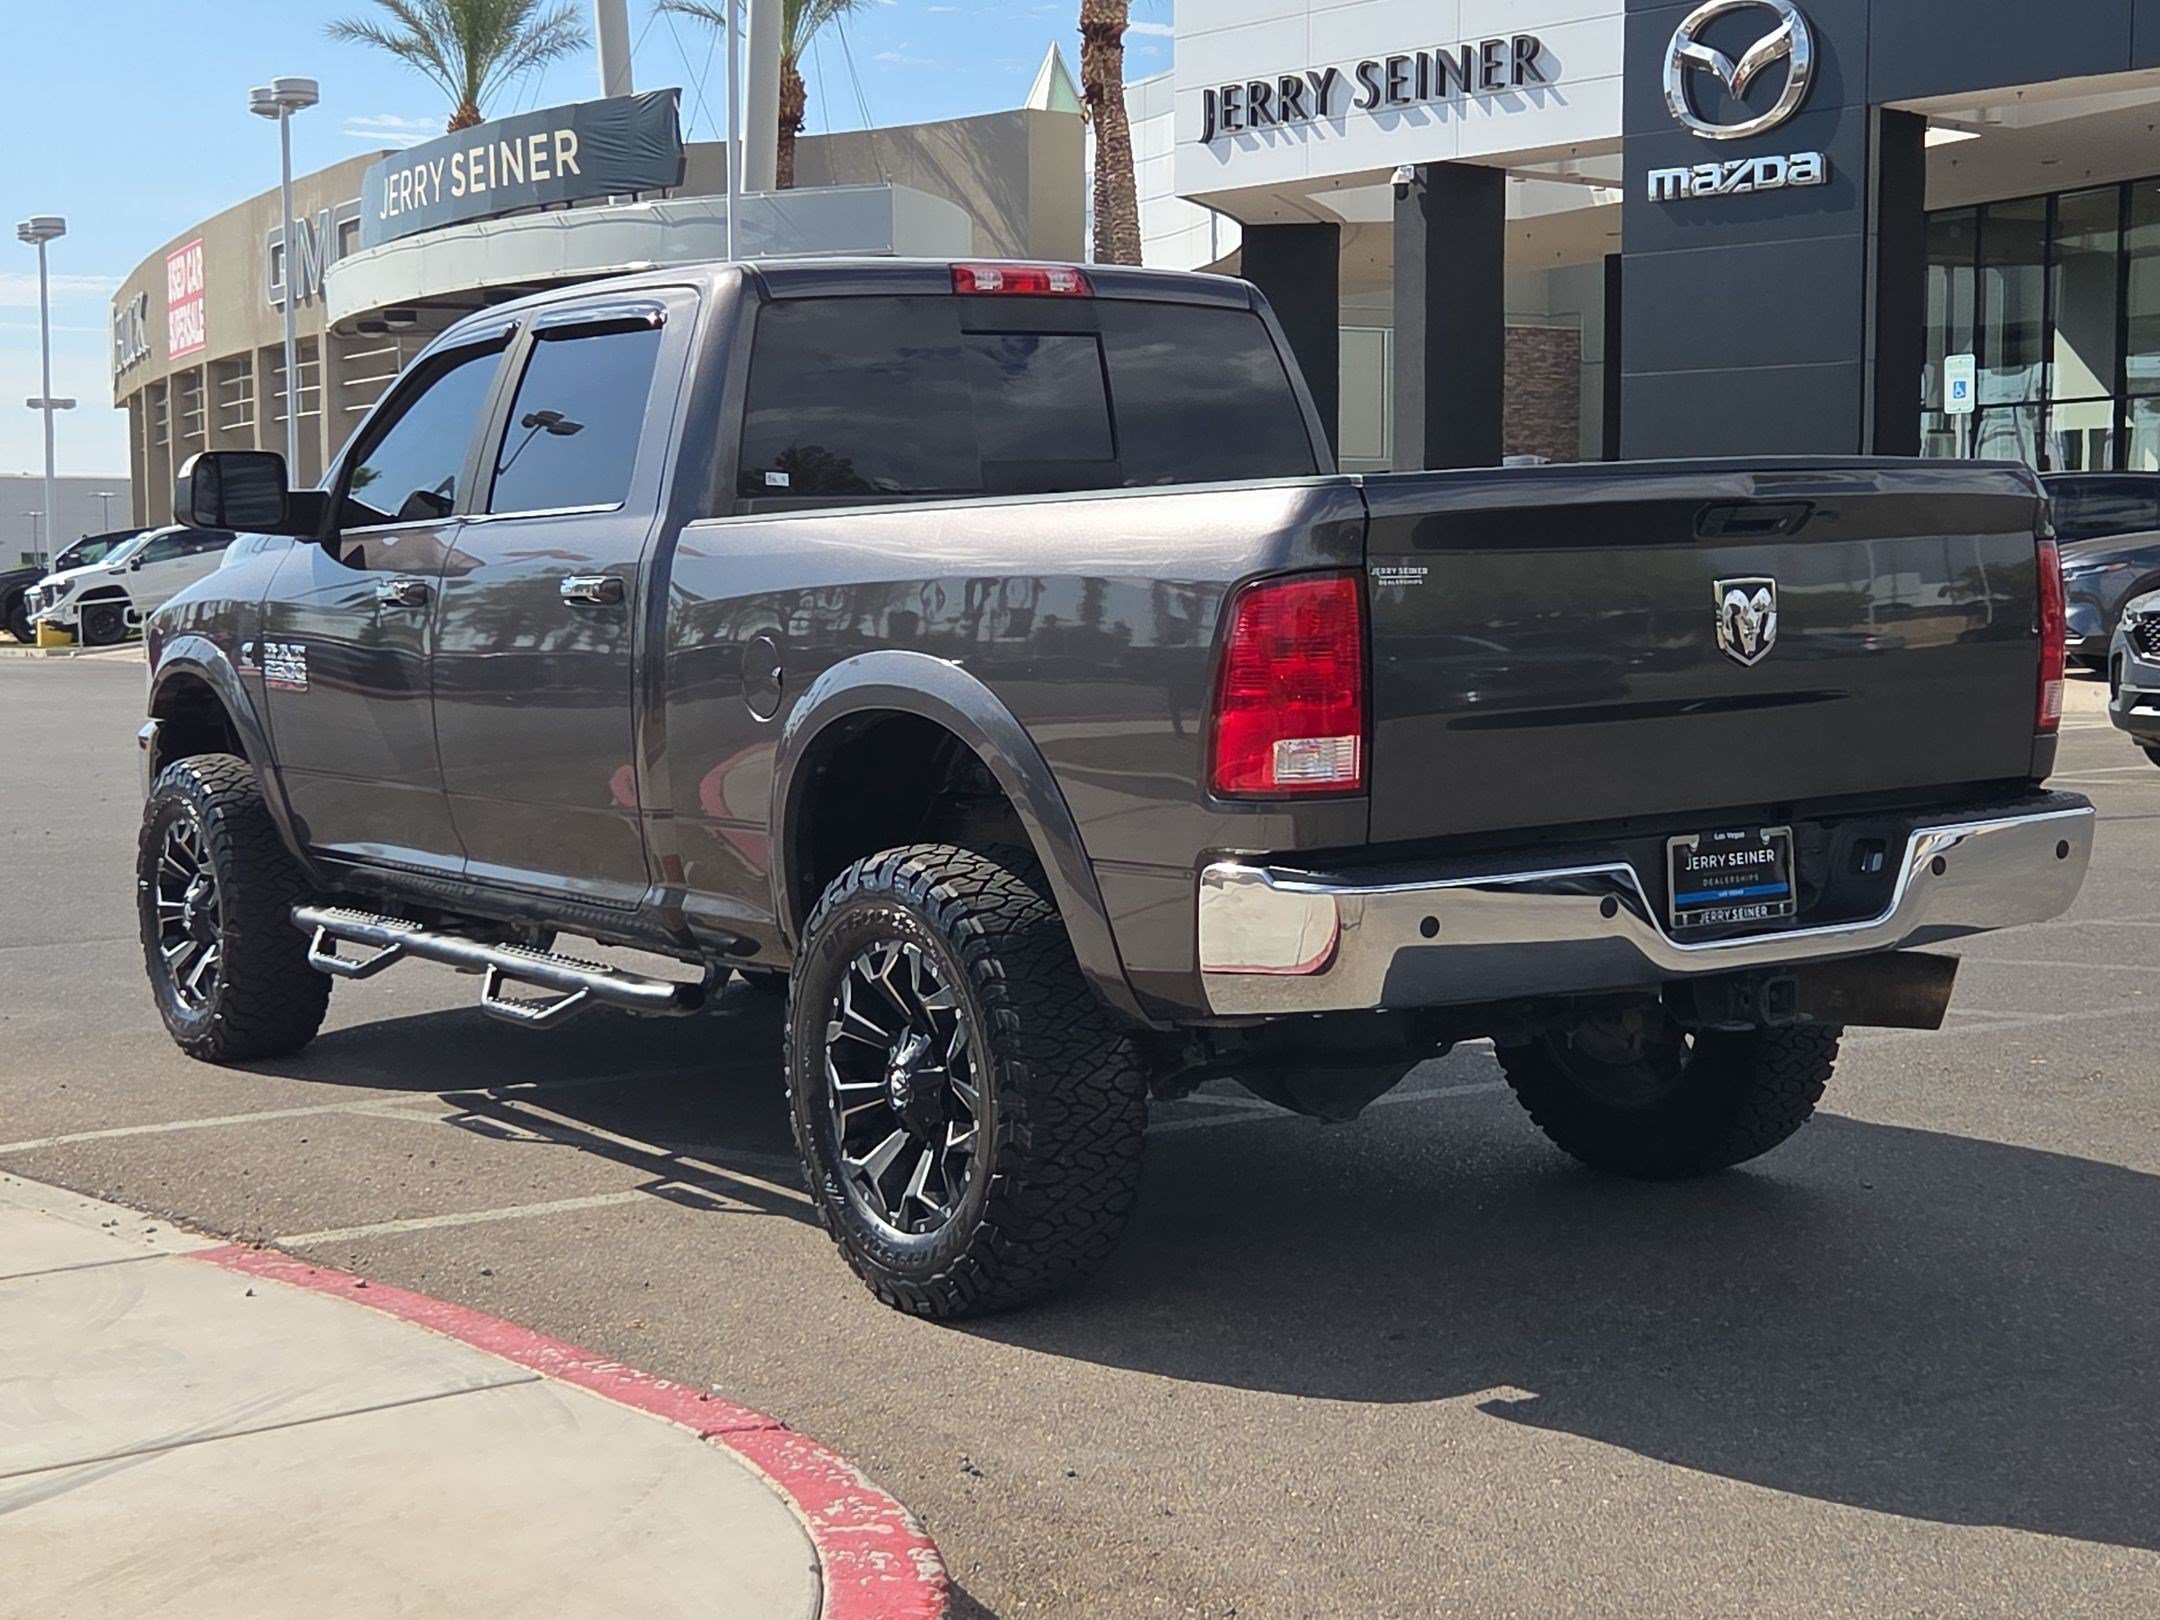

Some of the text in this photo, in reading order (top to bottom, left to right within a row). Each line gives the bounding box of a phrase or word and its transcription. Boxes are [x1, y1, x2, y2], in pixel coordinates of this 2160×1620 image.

[1198, 33, 1547, 144] JERRY SEINER
[379, 129, 581, 220] JERRY SEINER
[1371, 567, 1428, 576] JERRY SEINER
[1685, 849, 1775, 871] JERRY SEINER
[1702, 873, 1759, 887] DEALERSHIPS
[1699, 905, 1768, 924] JERRY SEINER
